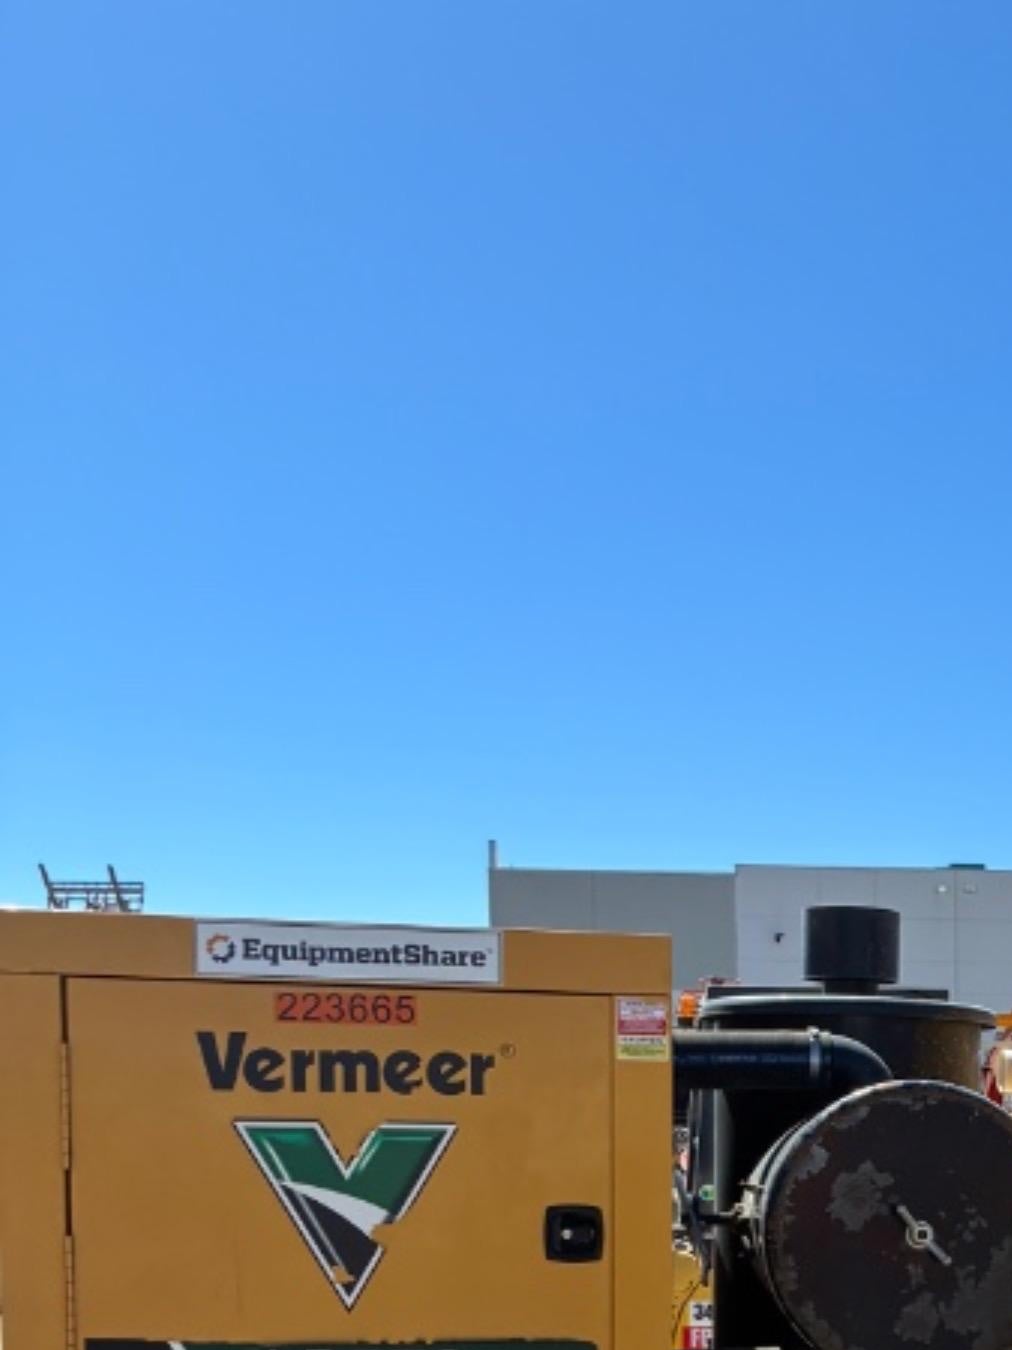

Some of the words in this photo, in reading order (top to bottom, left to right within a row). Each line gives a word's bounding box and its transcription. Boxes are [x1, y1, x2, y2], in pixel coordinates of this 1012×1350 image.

[242, 938, 487, 968] EquipmentShare
[277, 992, 415, 1024] 223665
[196, 1031, 495, 1095] Vermeer
